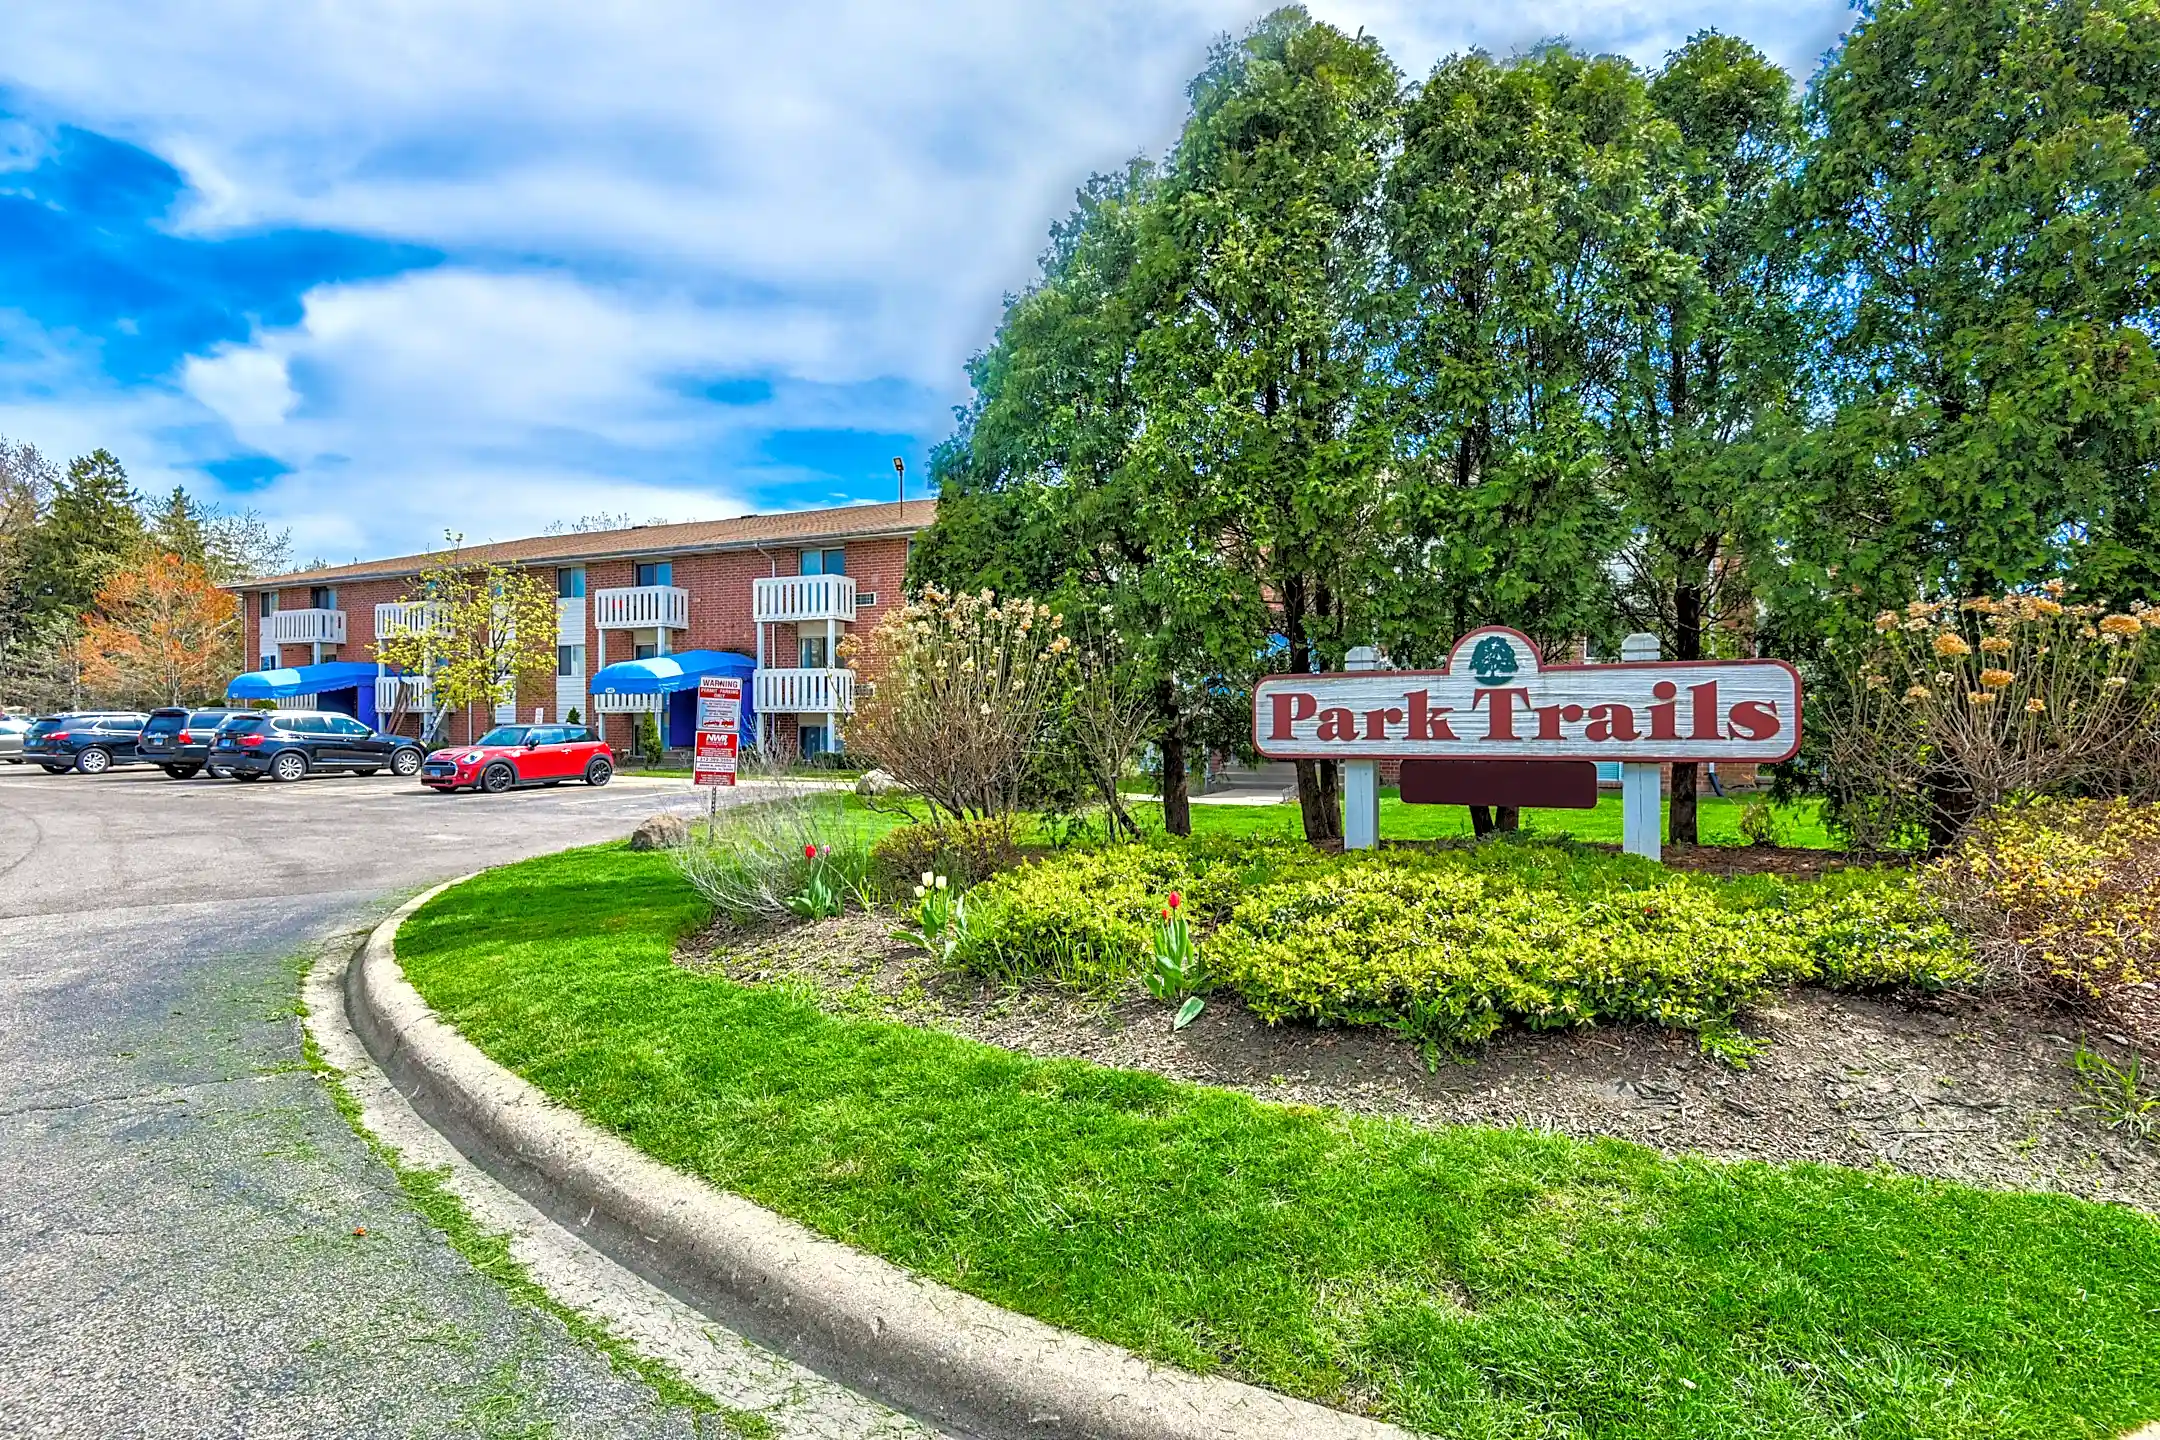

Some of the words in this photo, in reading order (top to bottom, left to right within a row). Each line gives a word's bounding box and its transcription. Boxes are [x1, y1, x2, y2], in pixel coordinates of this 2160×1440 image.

[702, 679, 738, 688] WARNING
[1266, 688, 1461, 742] Park
[1472, 679, 1781, 742] Trails
